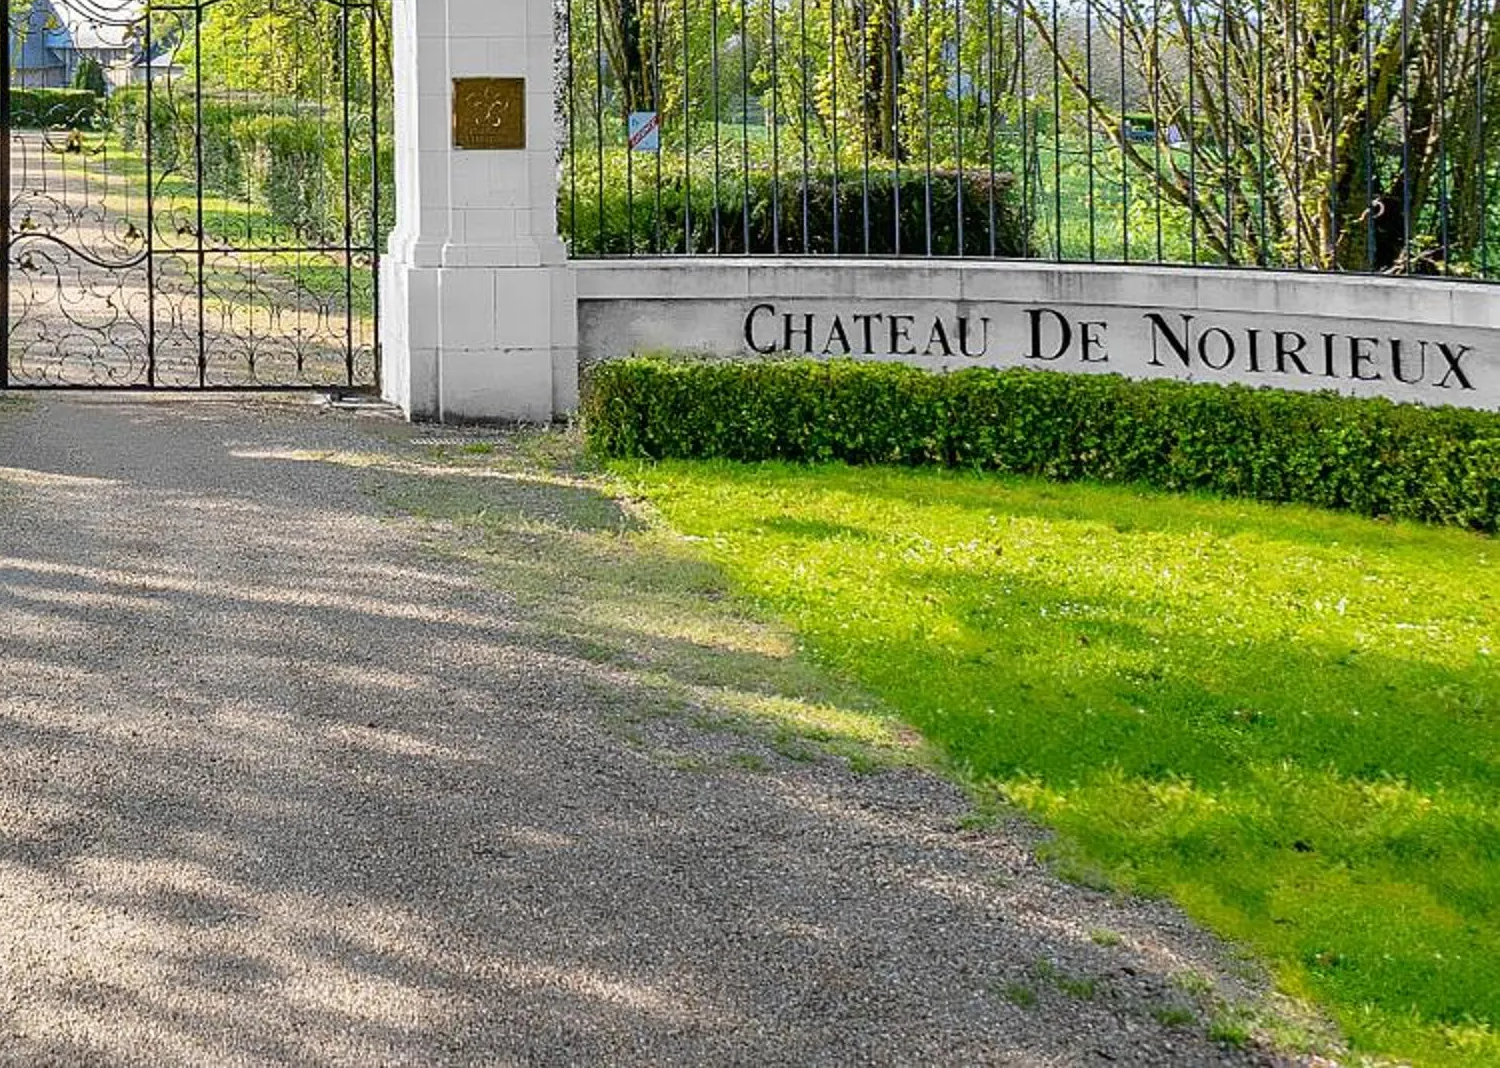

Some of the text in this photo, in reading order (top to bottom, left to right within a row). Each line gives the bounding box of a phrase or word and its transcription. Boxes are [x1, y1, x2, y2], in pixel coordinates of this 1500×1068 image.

[743, 303, 1477, 391] CHATEAU DE NOIRIEUX
